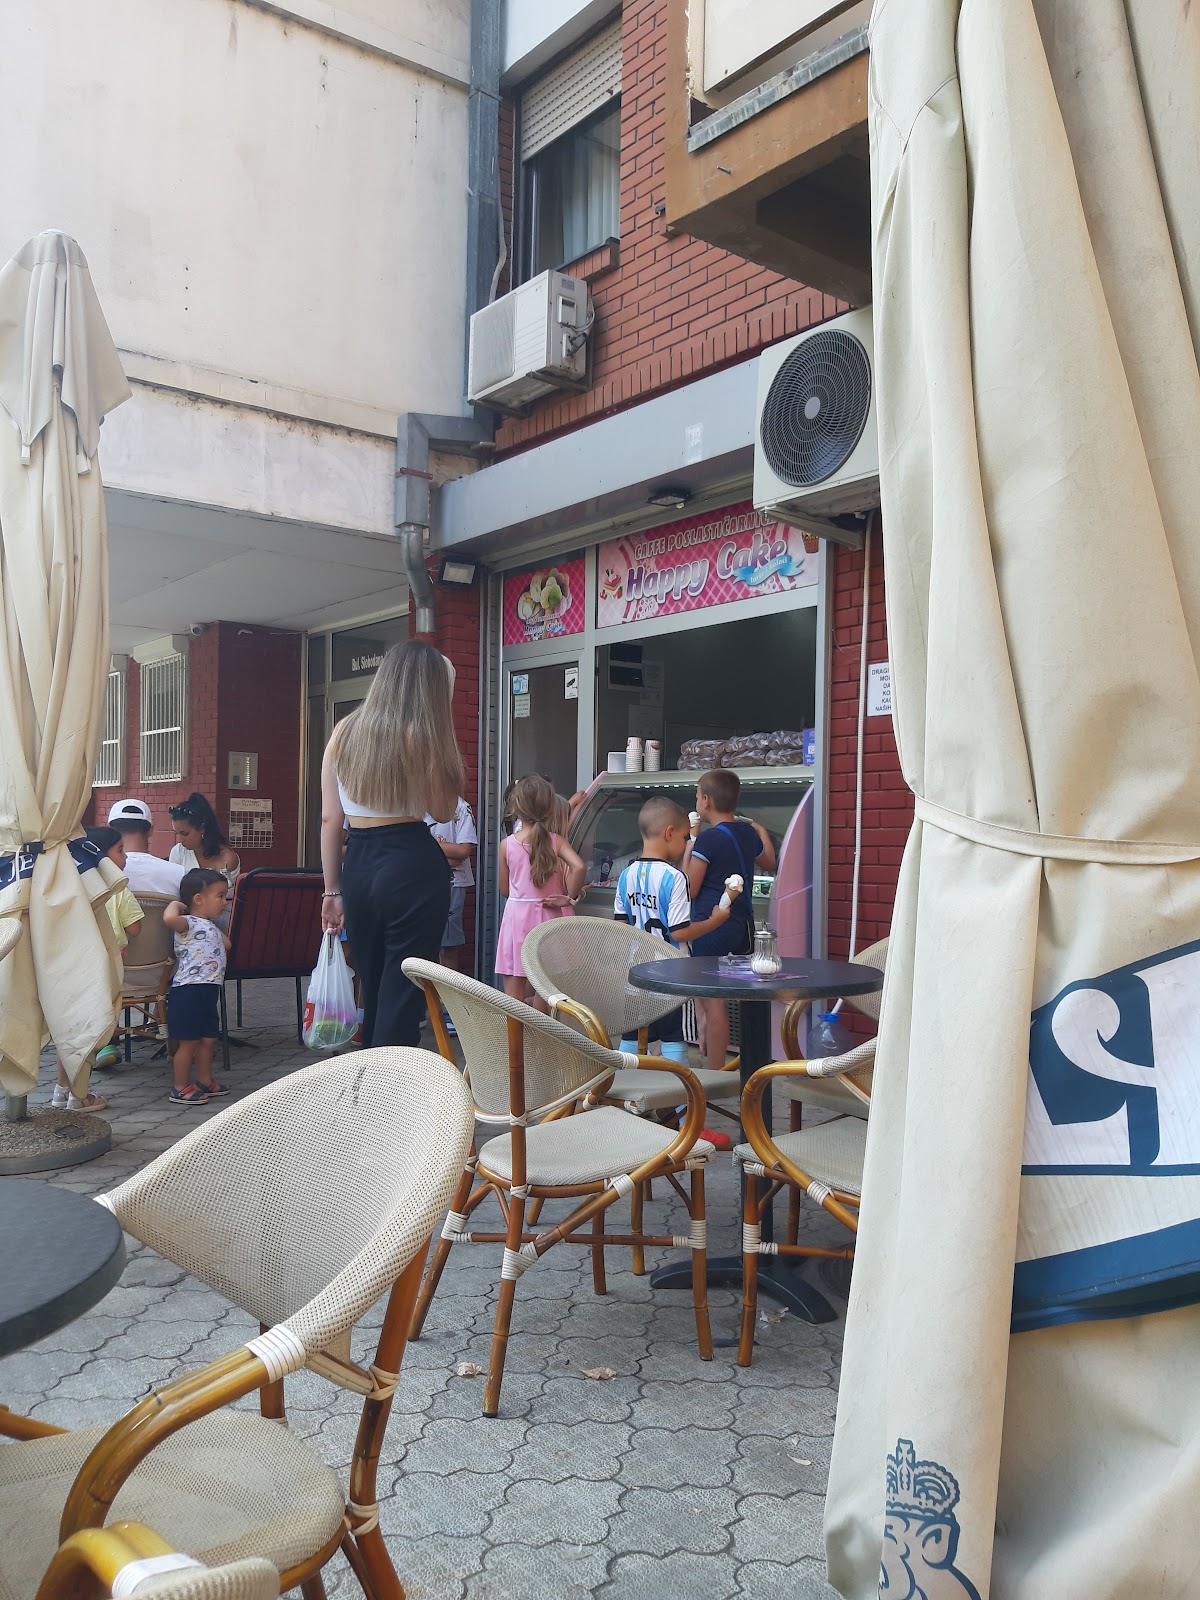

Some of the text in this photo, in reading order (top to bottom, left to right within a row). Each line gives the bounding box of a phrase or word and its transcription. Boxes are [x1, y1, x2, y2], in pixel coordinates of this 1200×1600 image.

[634, 511, 778, 561] CAFFE POSLASTIČARNIC
[625, 533, 787, 604] Happy Cake
[627, 892, 658, 910] MESSI
